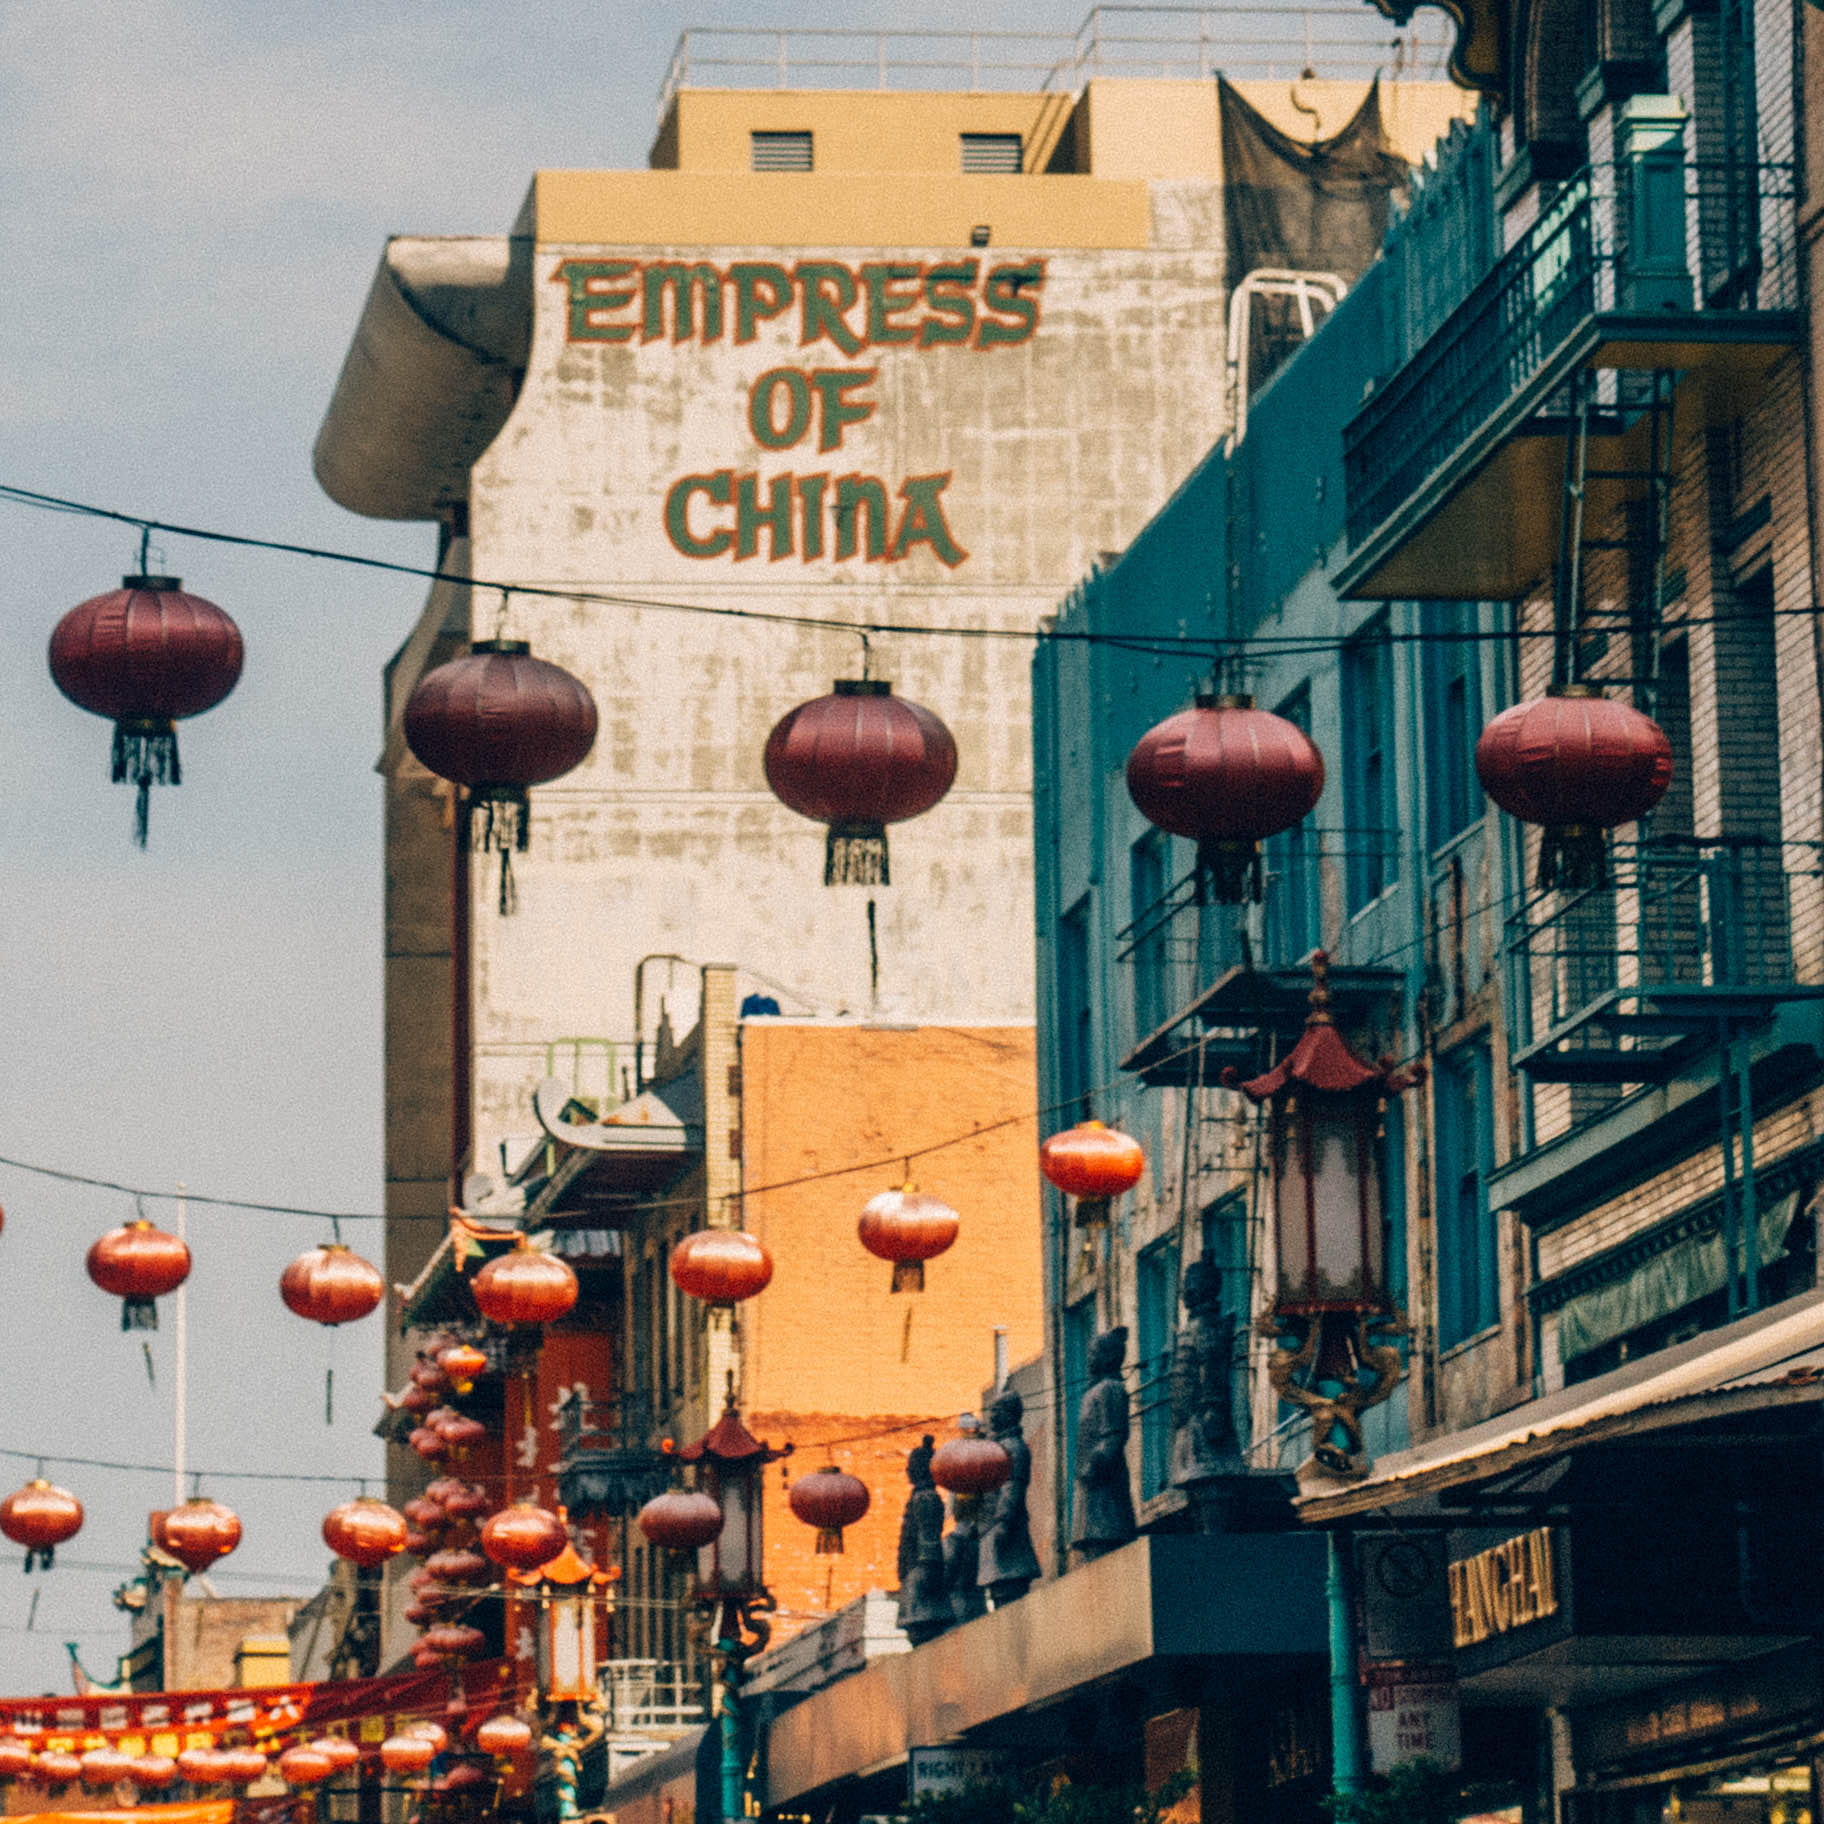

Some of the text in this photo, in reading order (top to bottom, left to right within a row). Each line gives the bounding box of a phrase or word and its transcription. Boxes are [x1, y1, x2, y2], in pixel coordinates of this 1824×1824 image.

[549, 257, 1050, 358] EMPRESS
[748, 366, 879, 454] OF
[663, 470, 970, 570] CHINA
[1396, 1732, 1434, 1749] TIME
[1397, 1710, 1432, 1728] ANY
